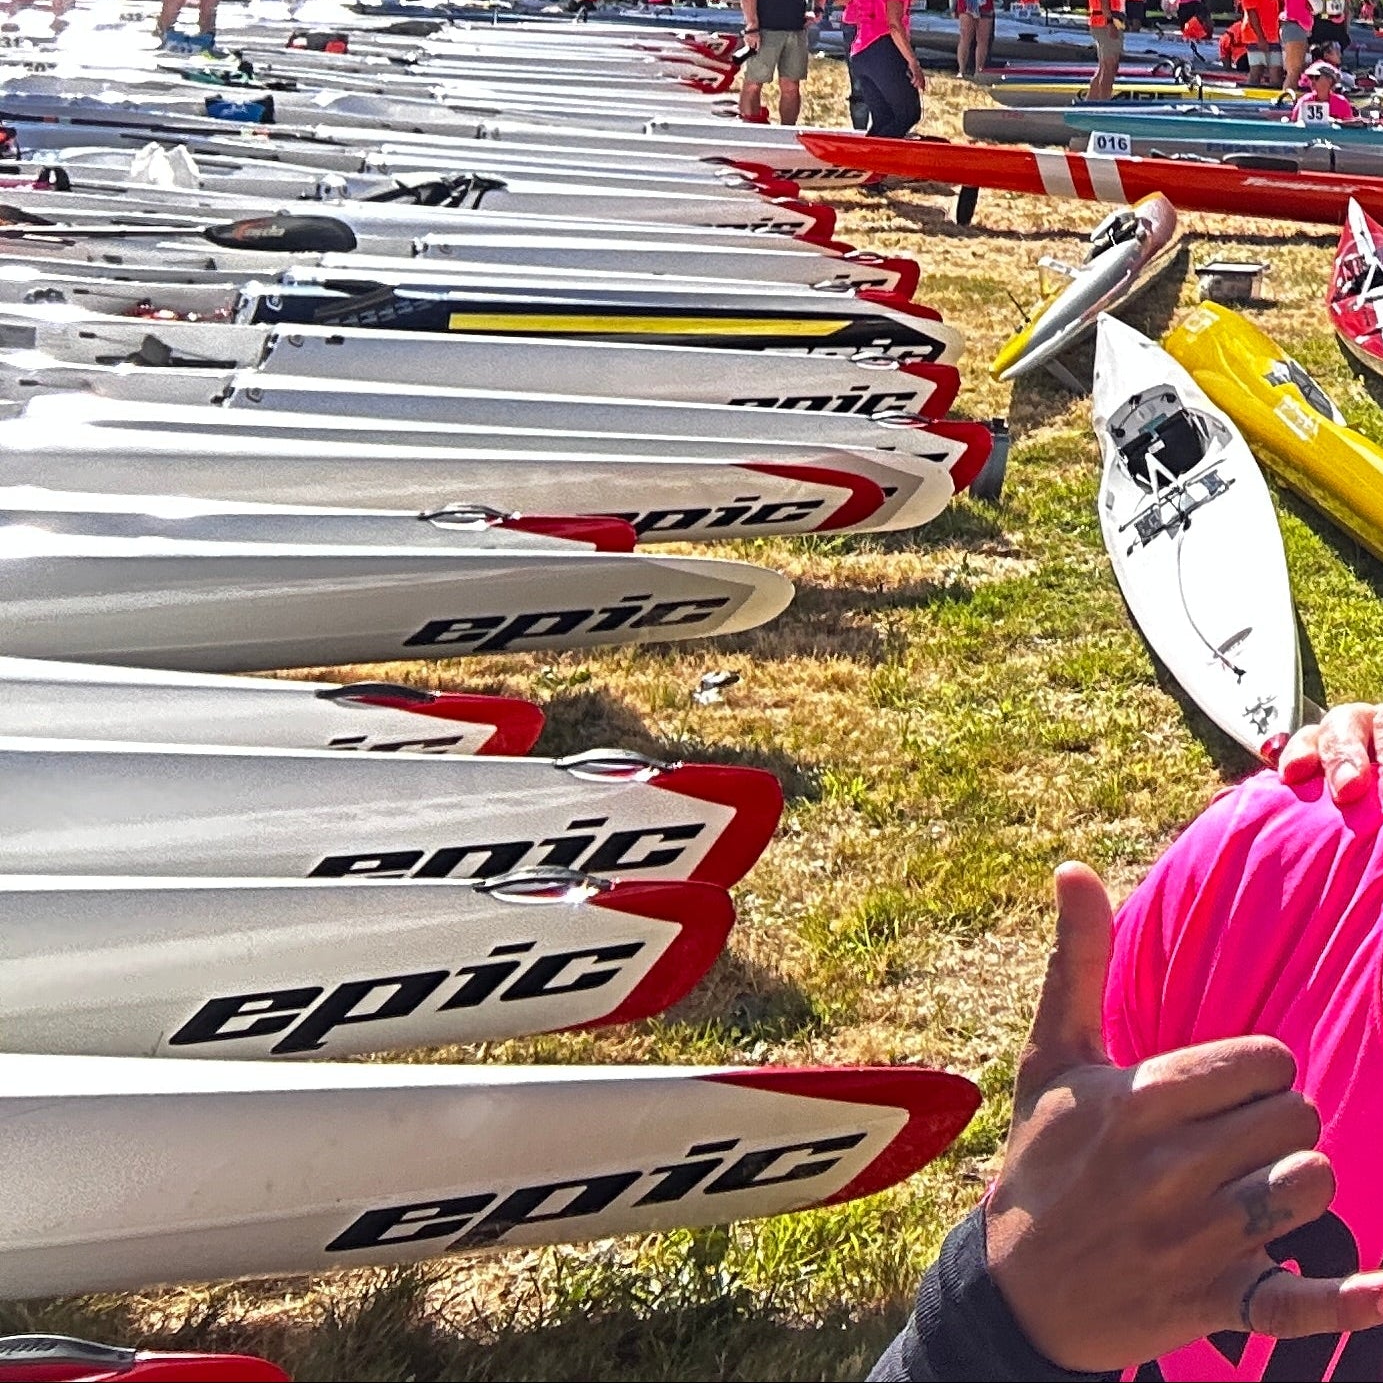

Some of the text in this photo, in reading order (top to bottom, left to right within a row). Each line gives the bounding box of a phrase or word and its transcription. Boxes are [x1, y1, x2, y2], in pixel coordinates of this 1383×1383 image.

[1307, 104, 1324, 120] 35
[1096, 135, 1129, 152] 016
[603, 495, 826, 535] pic
[402, 593, 731, 653] epic
[169, 939, 646, 1054] epic
[325, 1132, 866, 1252] epic
